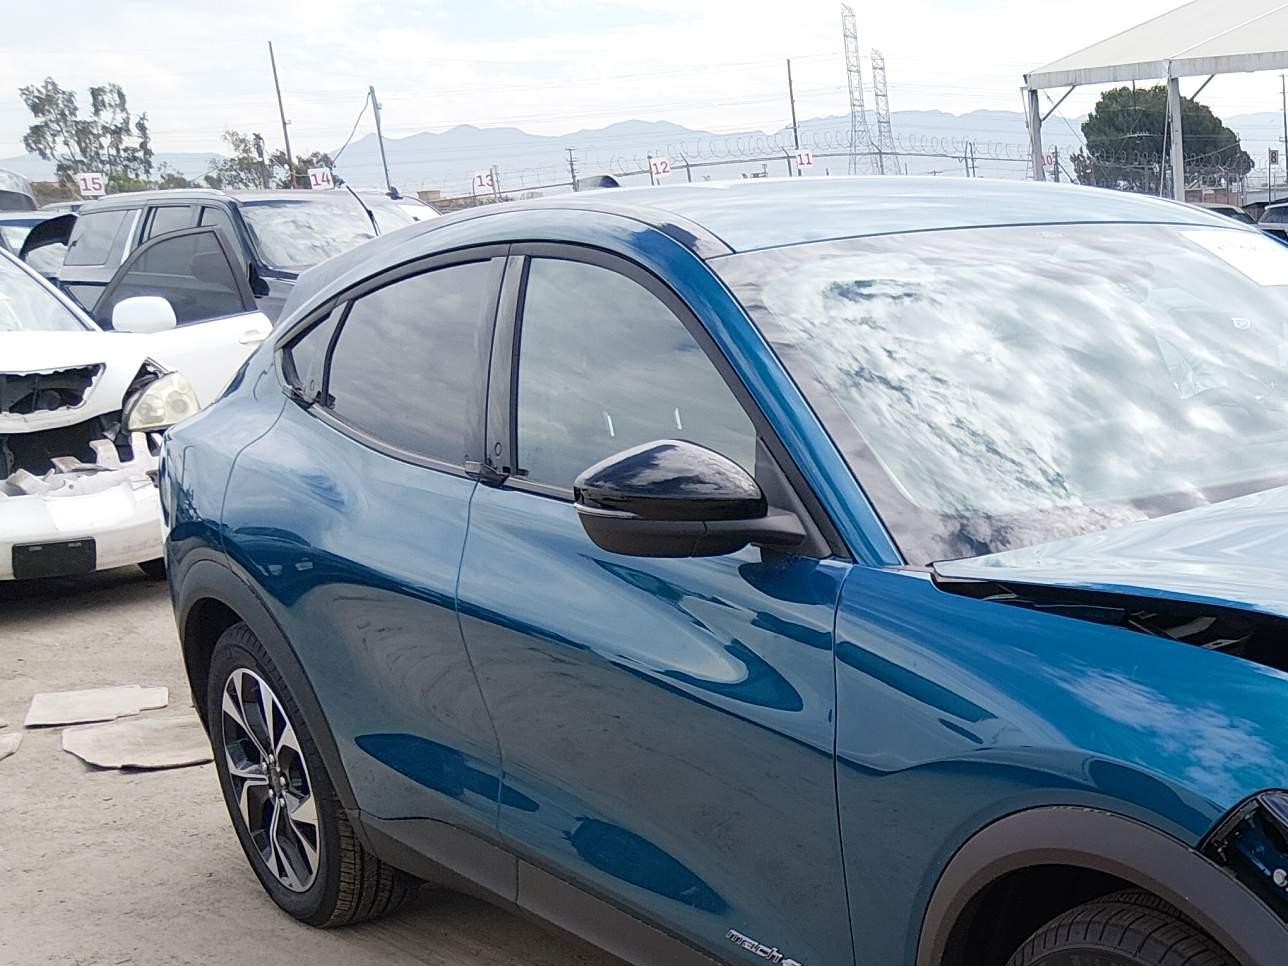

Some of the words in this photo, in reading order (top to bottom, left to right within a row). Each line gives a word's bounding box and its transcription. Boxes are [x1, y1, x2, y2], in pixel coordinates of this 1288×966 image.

[797, 153, 813, 166] 11
[652, 160, 671, 176] 12
[80, 177, 103, 192] 15
[310, 171, 331, 187] 14
[475, 174, 494, 187] 13
